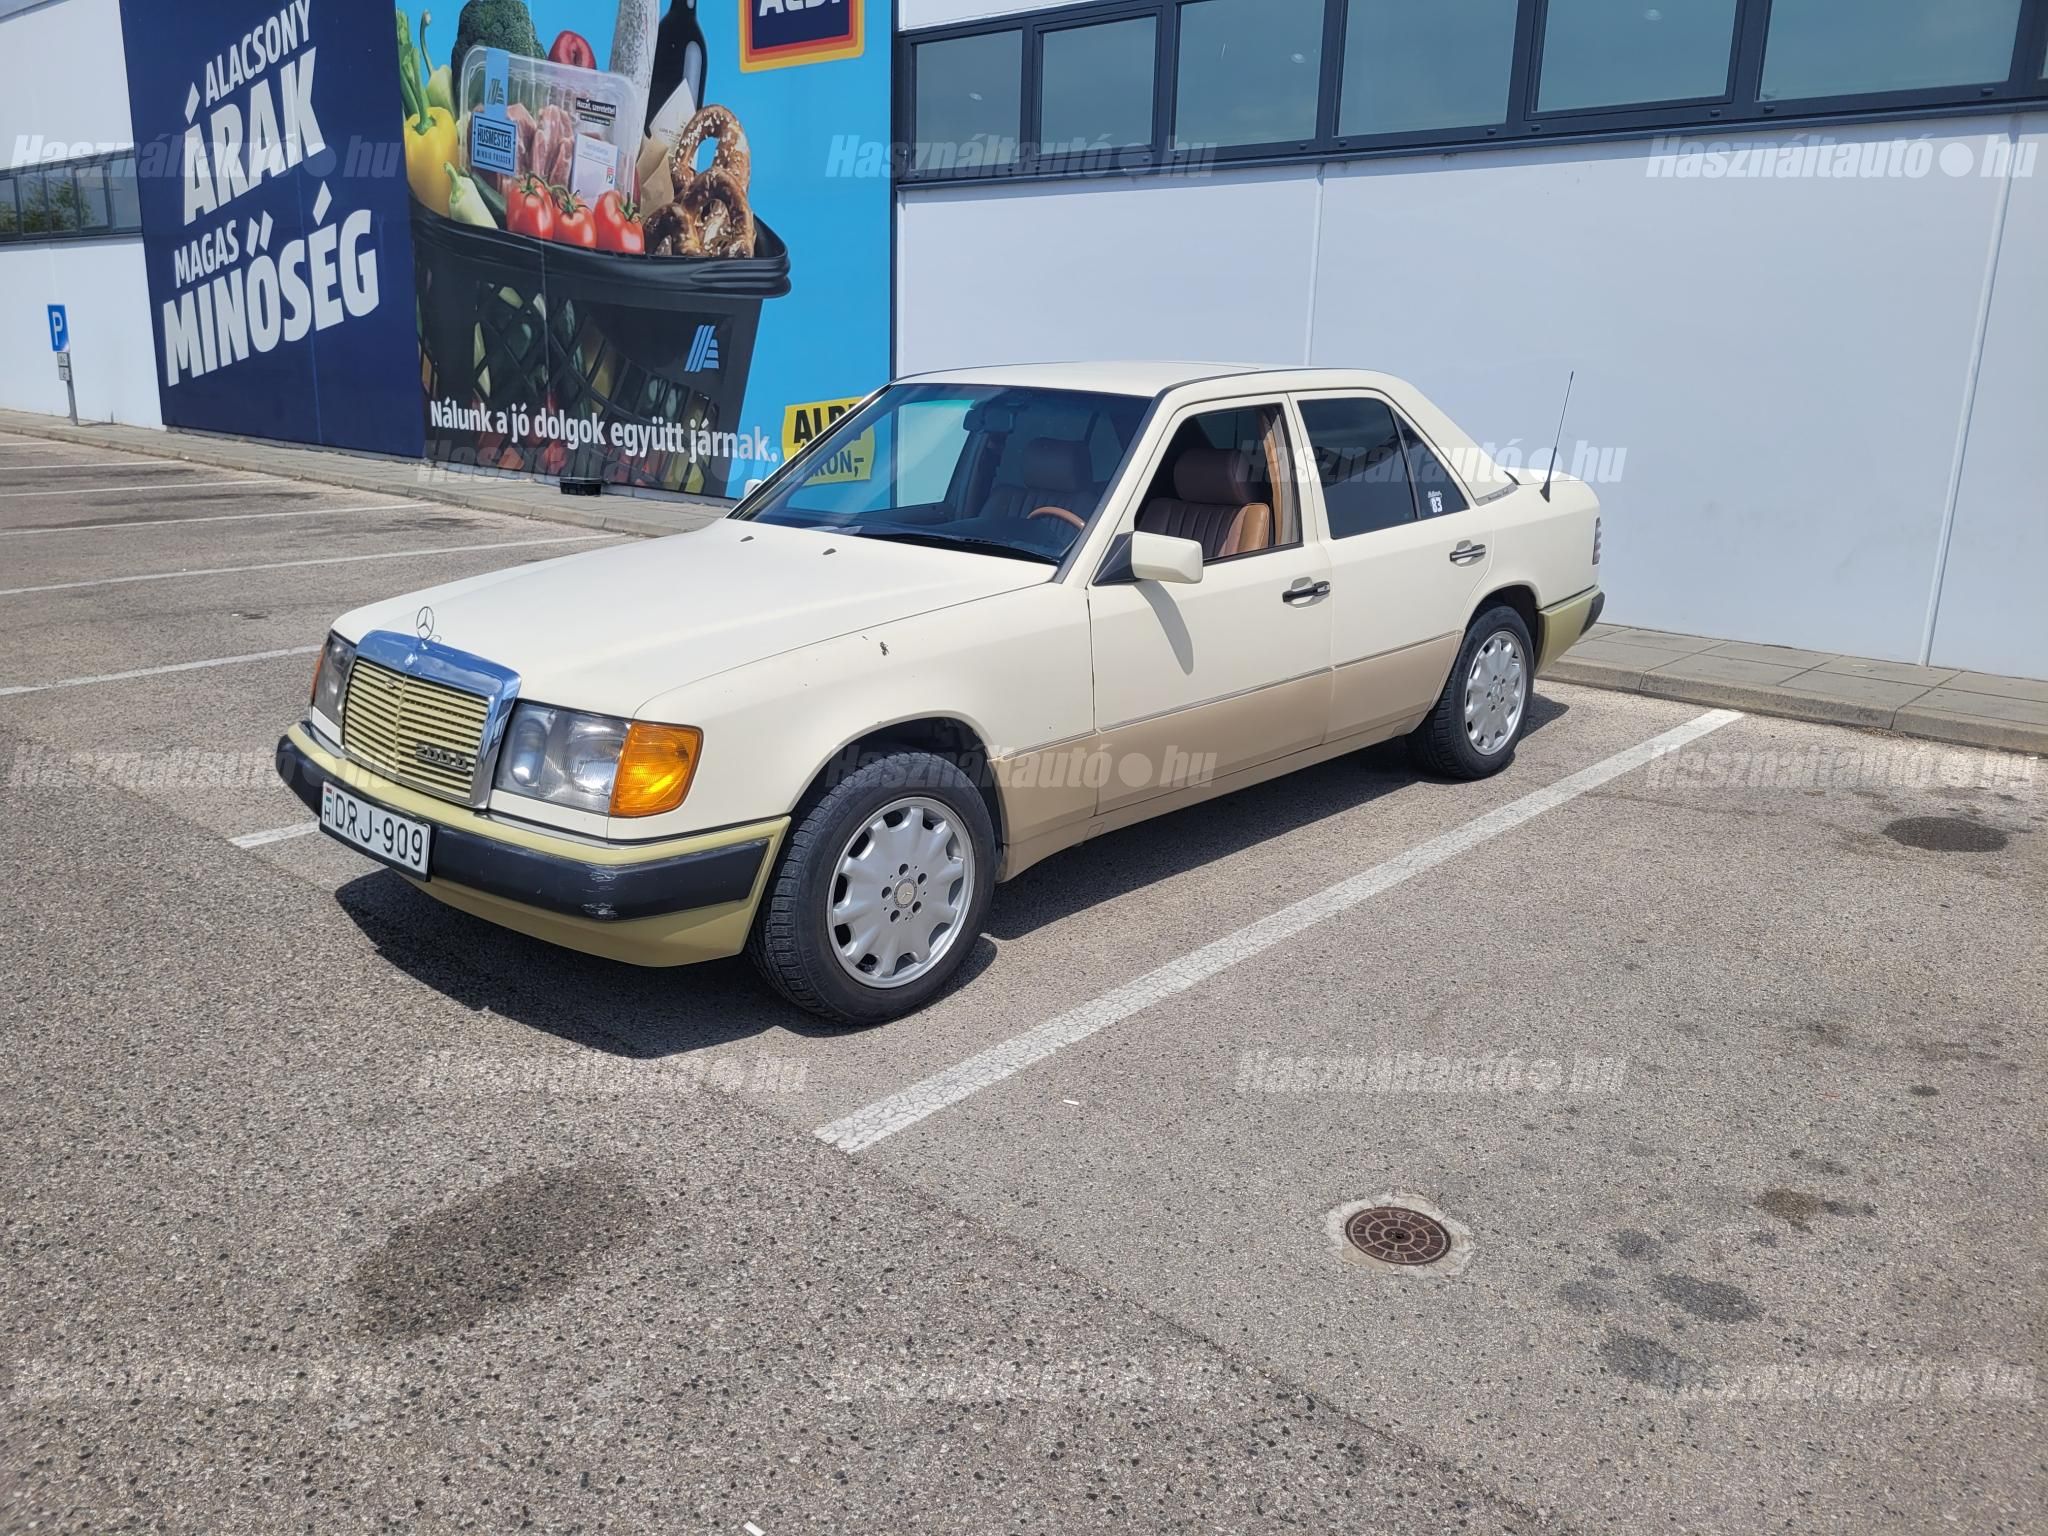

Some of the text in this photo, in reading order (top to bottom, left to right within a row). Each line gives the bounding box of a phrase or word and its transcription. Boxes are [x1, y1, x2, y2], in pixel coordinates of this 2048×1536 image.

[206, 0, 311, 107] ALACSONY
[184, 47, 326, 226] ÁRAK
[478, 128, 512, 149] HUSMESTER
[163, 181, 380, 387] MINŐSÉG
[174, 220, 240, 288] MAGAS
[52, 312, 63, 346] P
[430, 398, 778, 463] Nálunk a jó dolgok együtt járnak.
[794, 403, 862, 444] AL
[336, 793, 423, 866] DRJ-909
